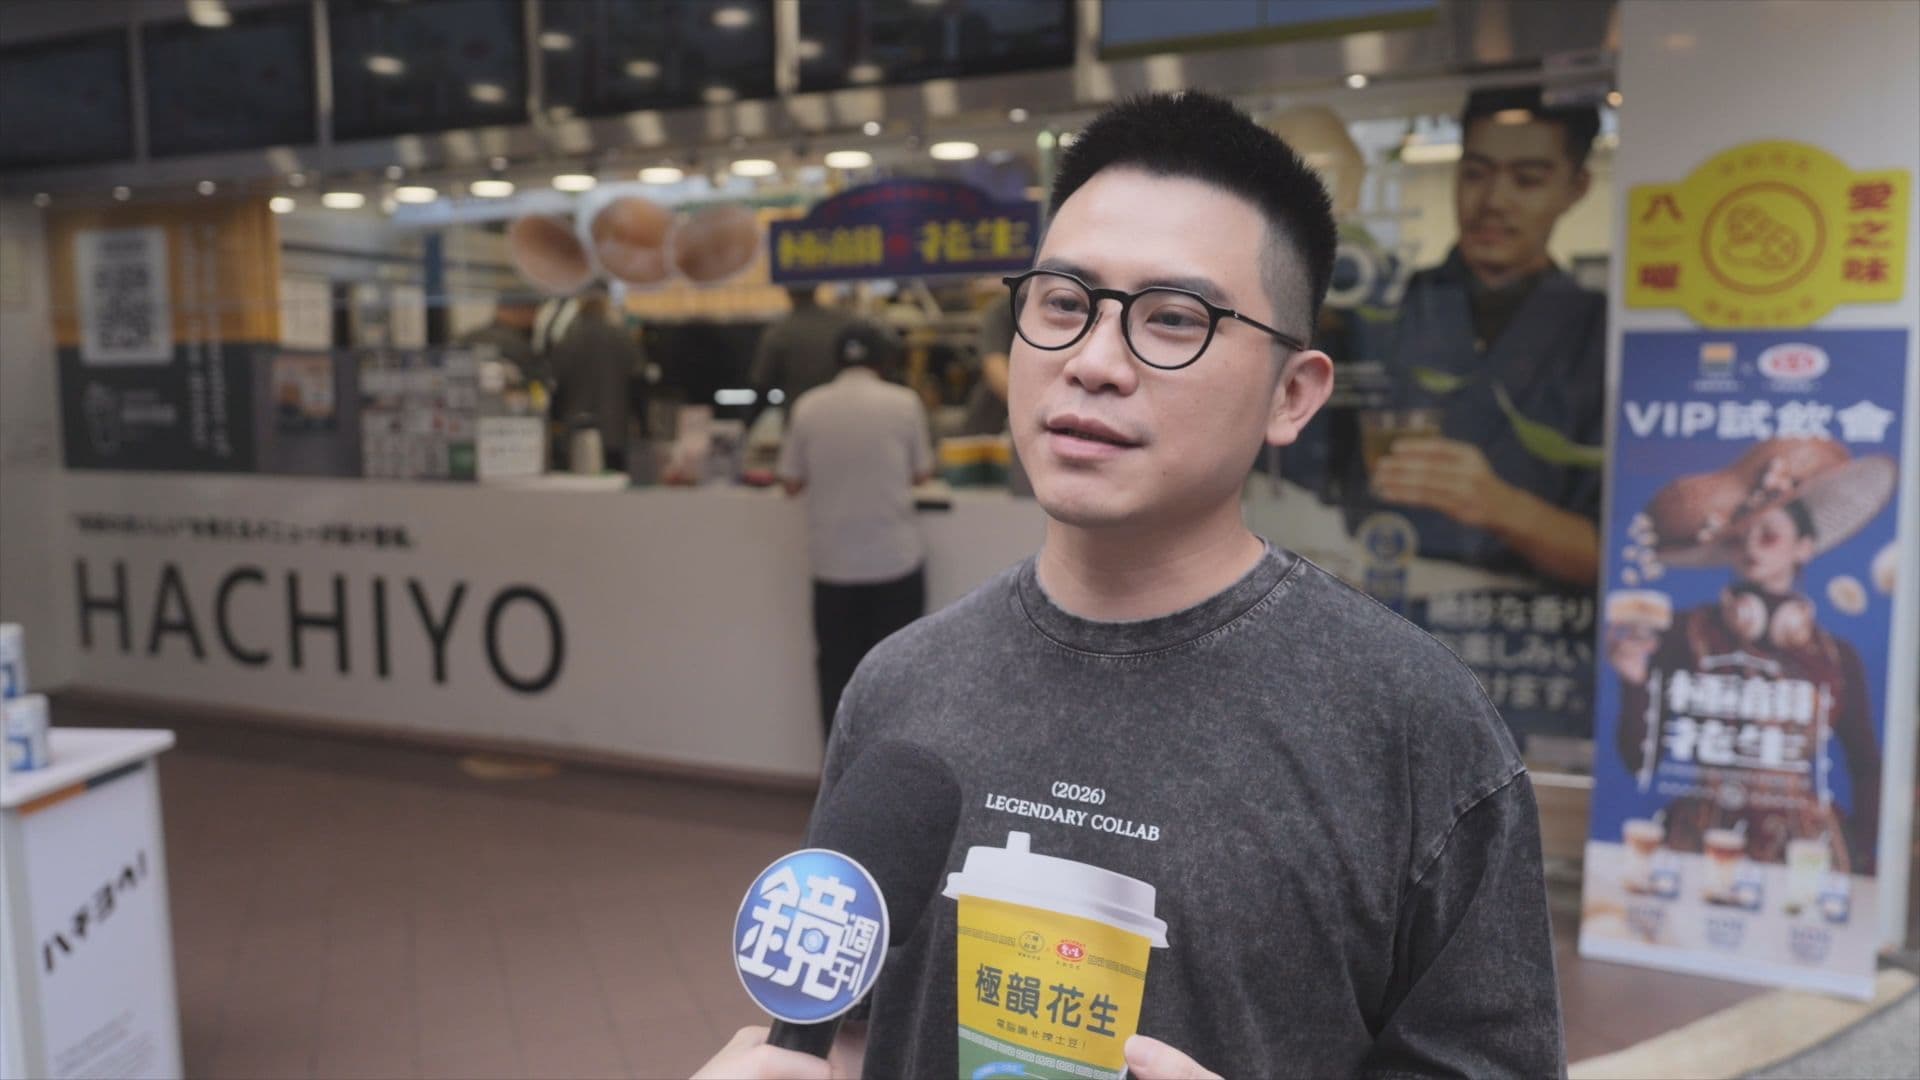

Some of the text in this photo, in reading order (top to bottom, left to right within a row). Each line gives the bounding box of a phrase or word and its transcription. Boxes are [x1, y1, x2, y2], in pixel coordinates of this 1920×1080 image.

[920, 216, 1032, 264] 花生
[1842, 182, 1895, 284] 愛之味
[1624, 400, 1894, 443] VIP試飲會
[75, 558, 566, 694] HACHIYO
[1662, 717, 1812, 771] 花生
[985, 793, 1160, 842] LEGENDARY COLLAB
[1051, 781, 1106, 805] (2026)
[975, 962, 1119, 1039] 極韻花生
